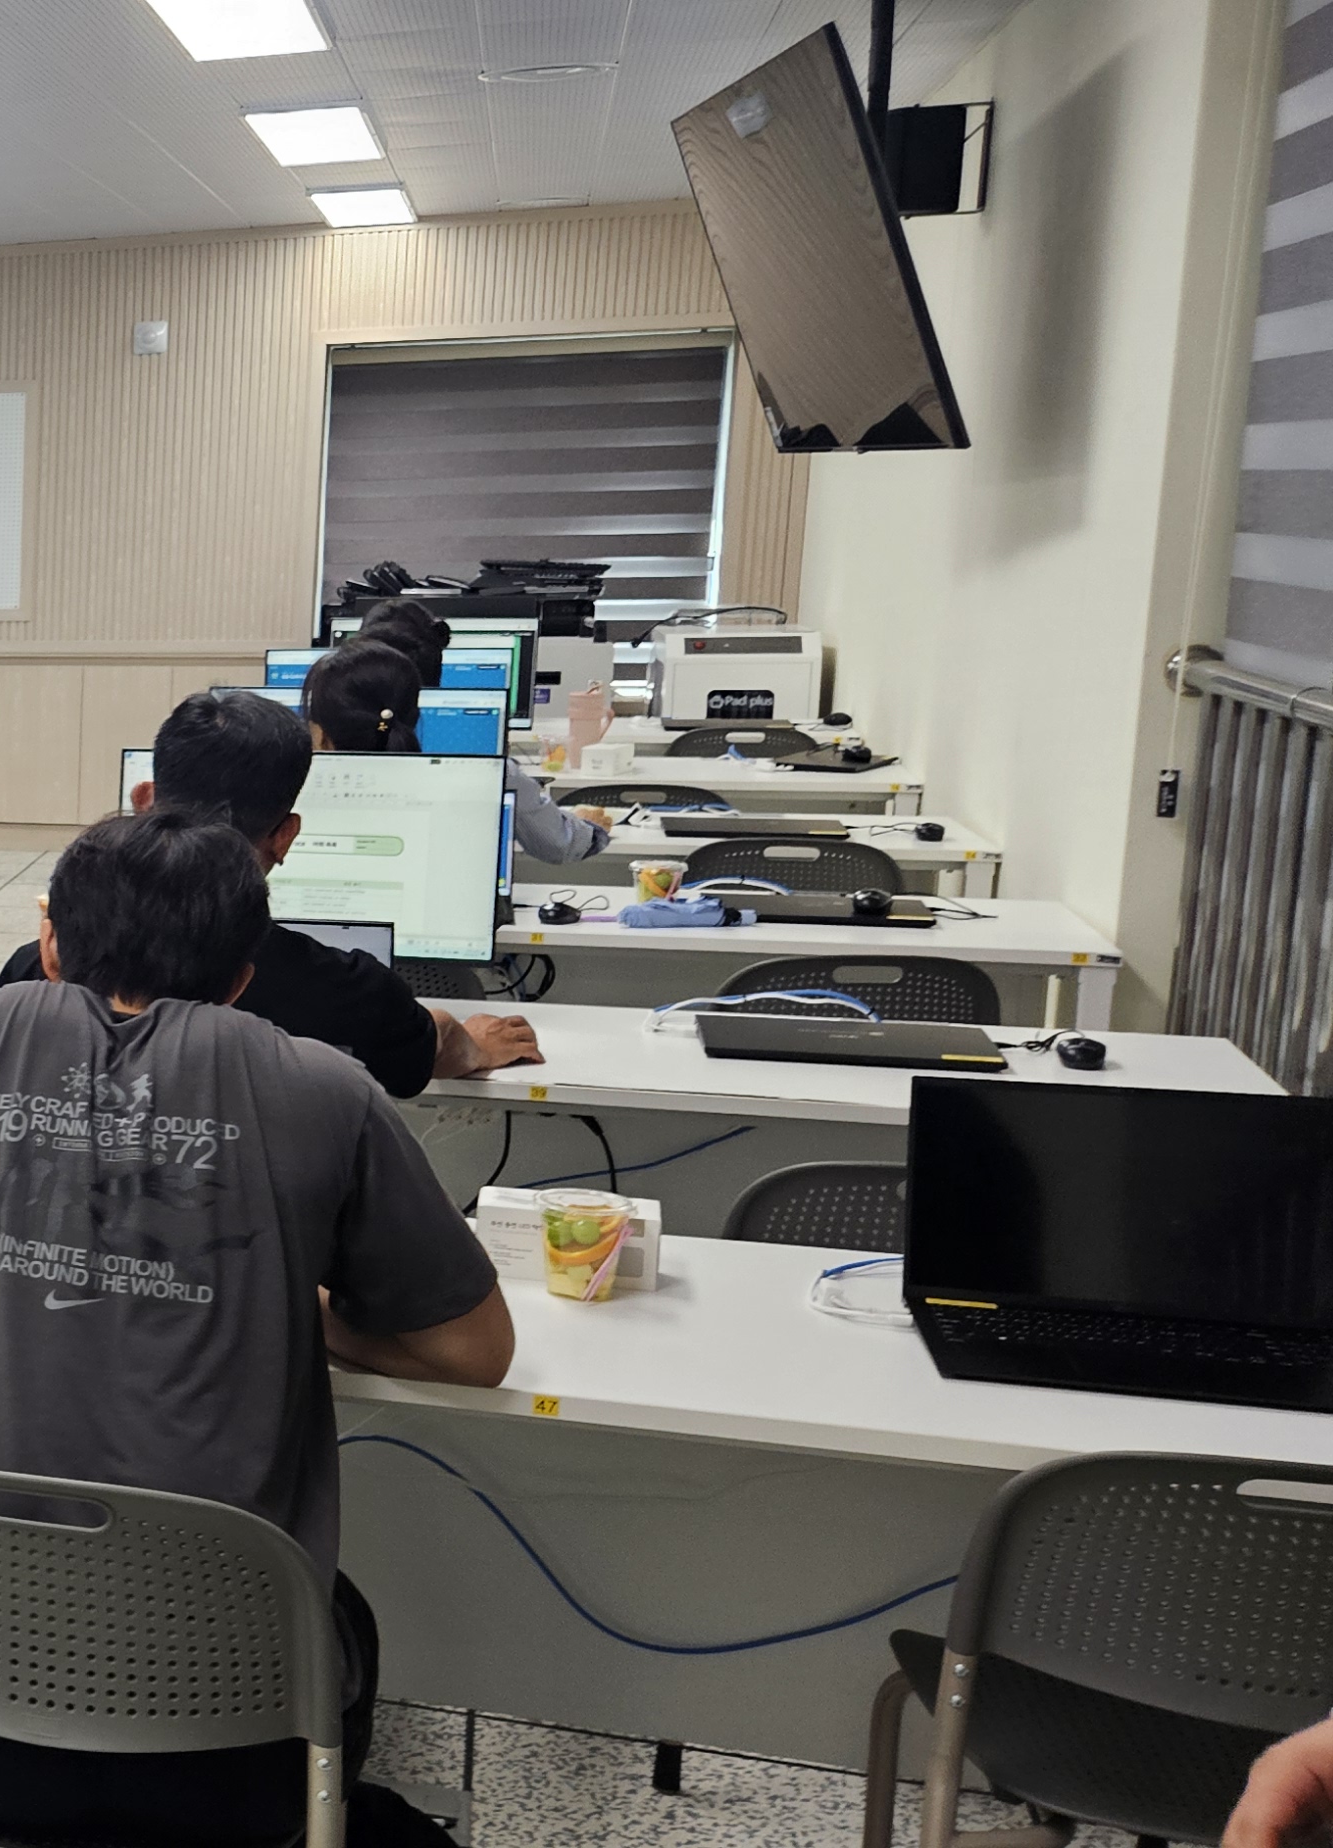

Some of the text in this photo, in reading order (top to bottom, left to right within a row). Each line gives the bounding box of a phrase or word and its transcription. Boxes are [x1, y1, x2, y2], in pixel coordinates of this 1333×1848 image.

[171, 1133, 217, 1170] 72
[130, 1276, 214, 1303] WORLD
[535, 1399, 558, 1413] 47
